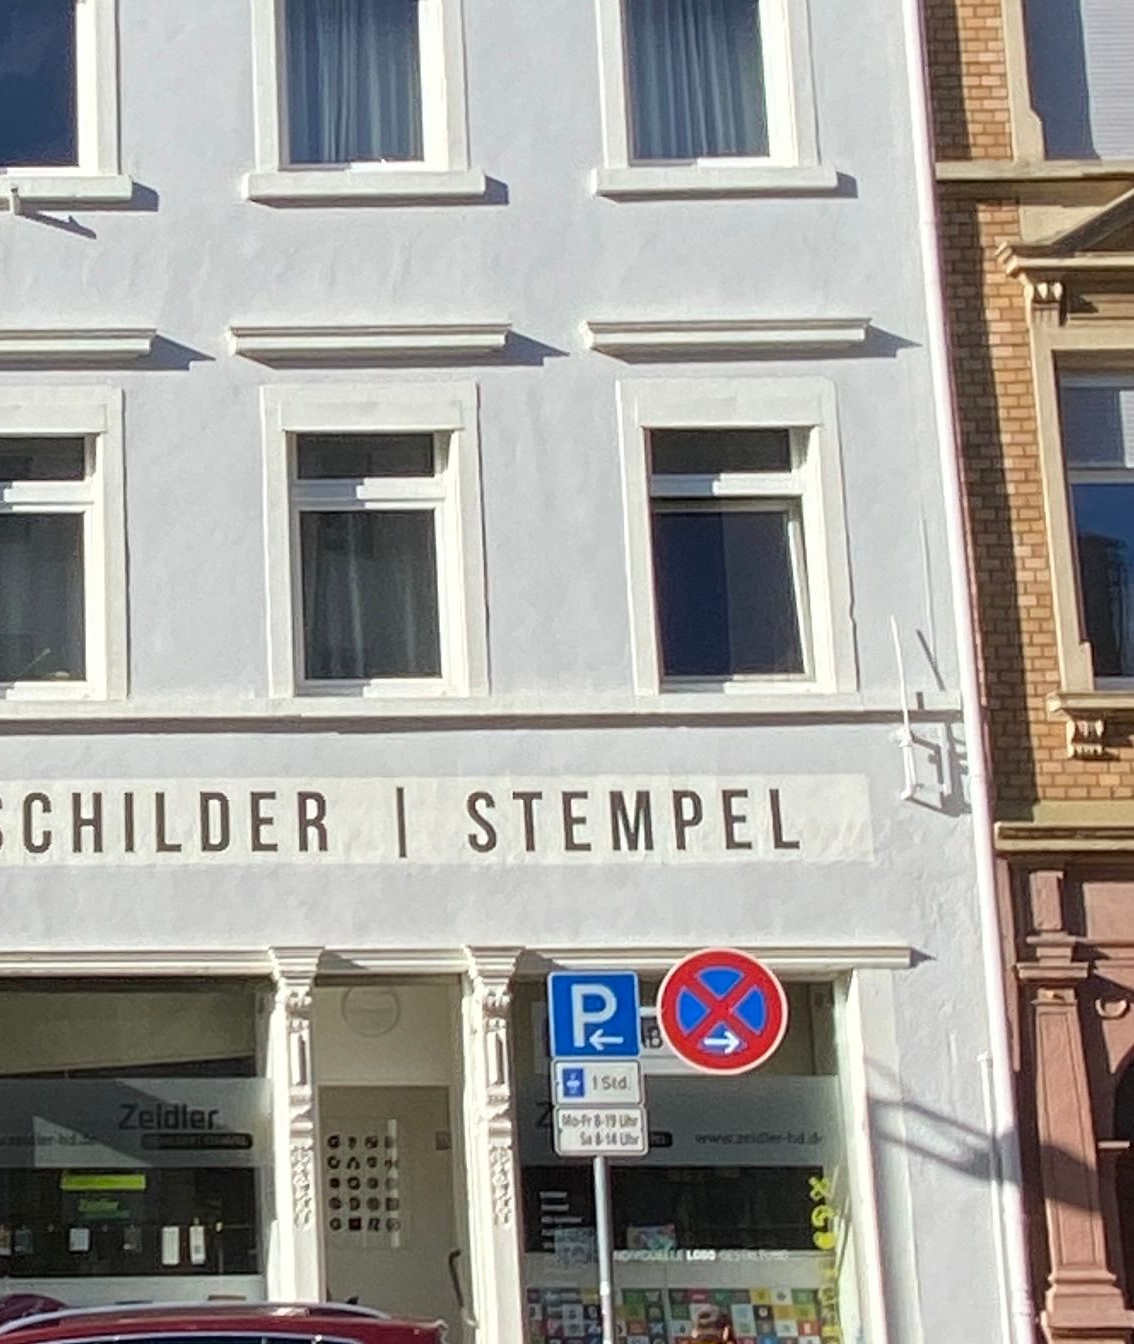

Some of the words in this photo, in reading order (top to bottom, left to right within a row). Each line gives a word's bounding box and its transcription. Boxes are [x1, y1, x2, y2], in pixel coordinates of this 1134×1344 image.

[467, 787, 801, 853] STEMPEL
[571, 983, 618, 1048] P
[619, 1113, 639, 1129] Uhr
[620, 1131, 640, 1146] Uhr
